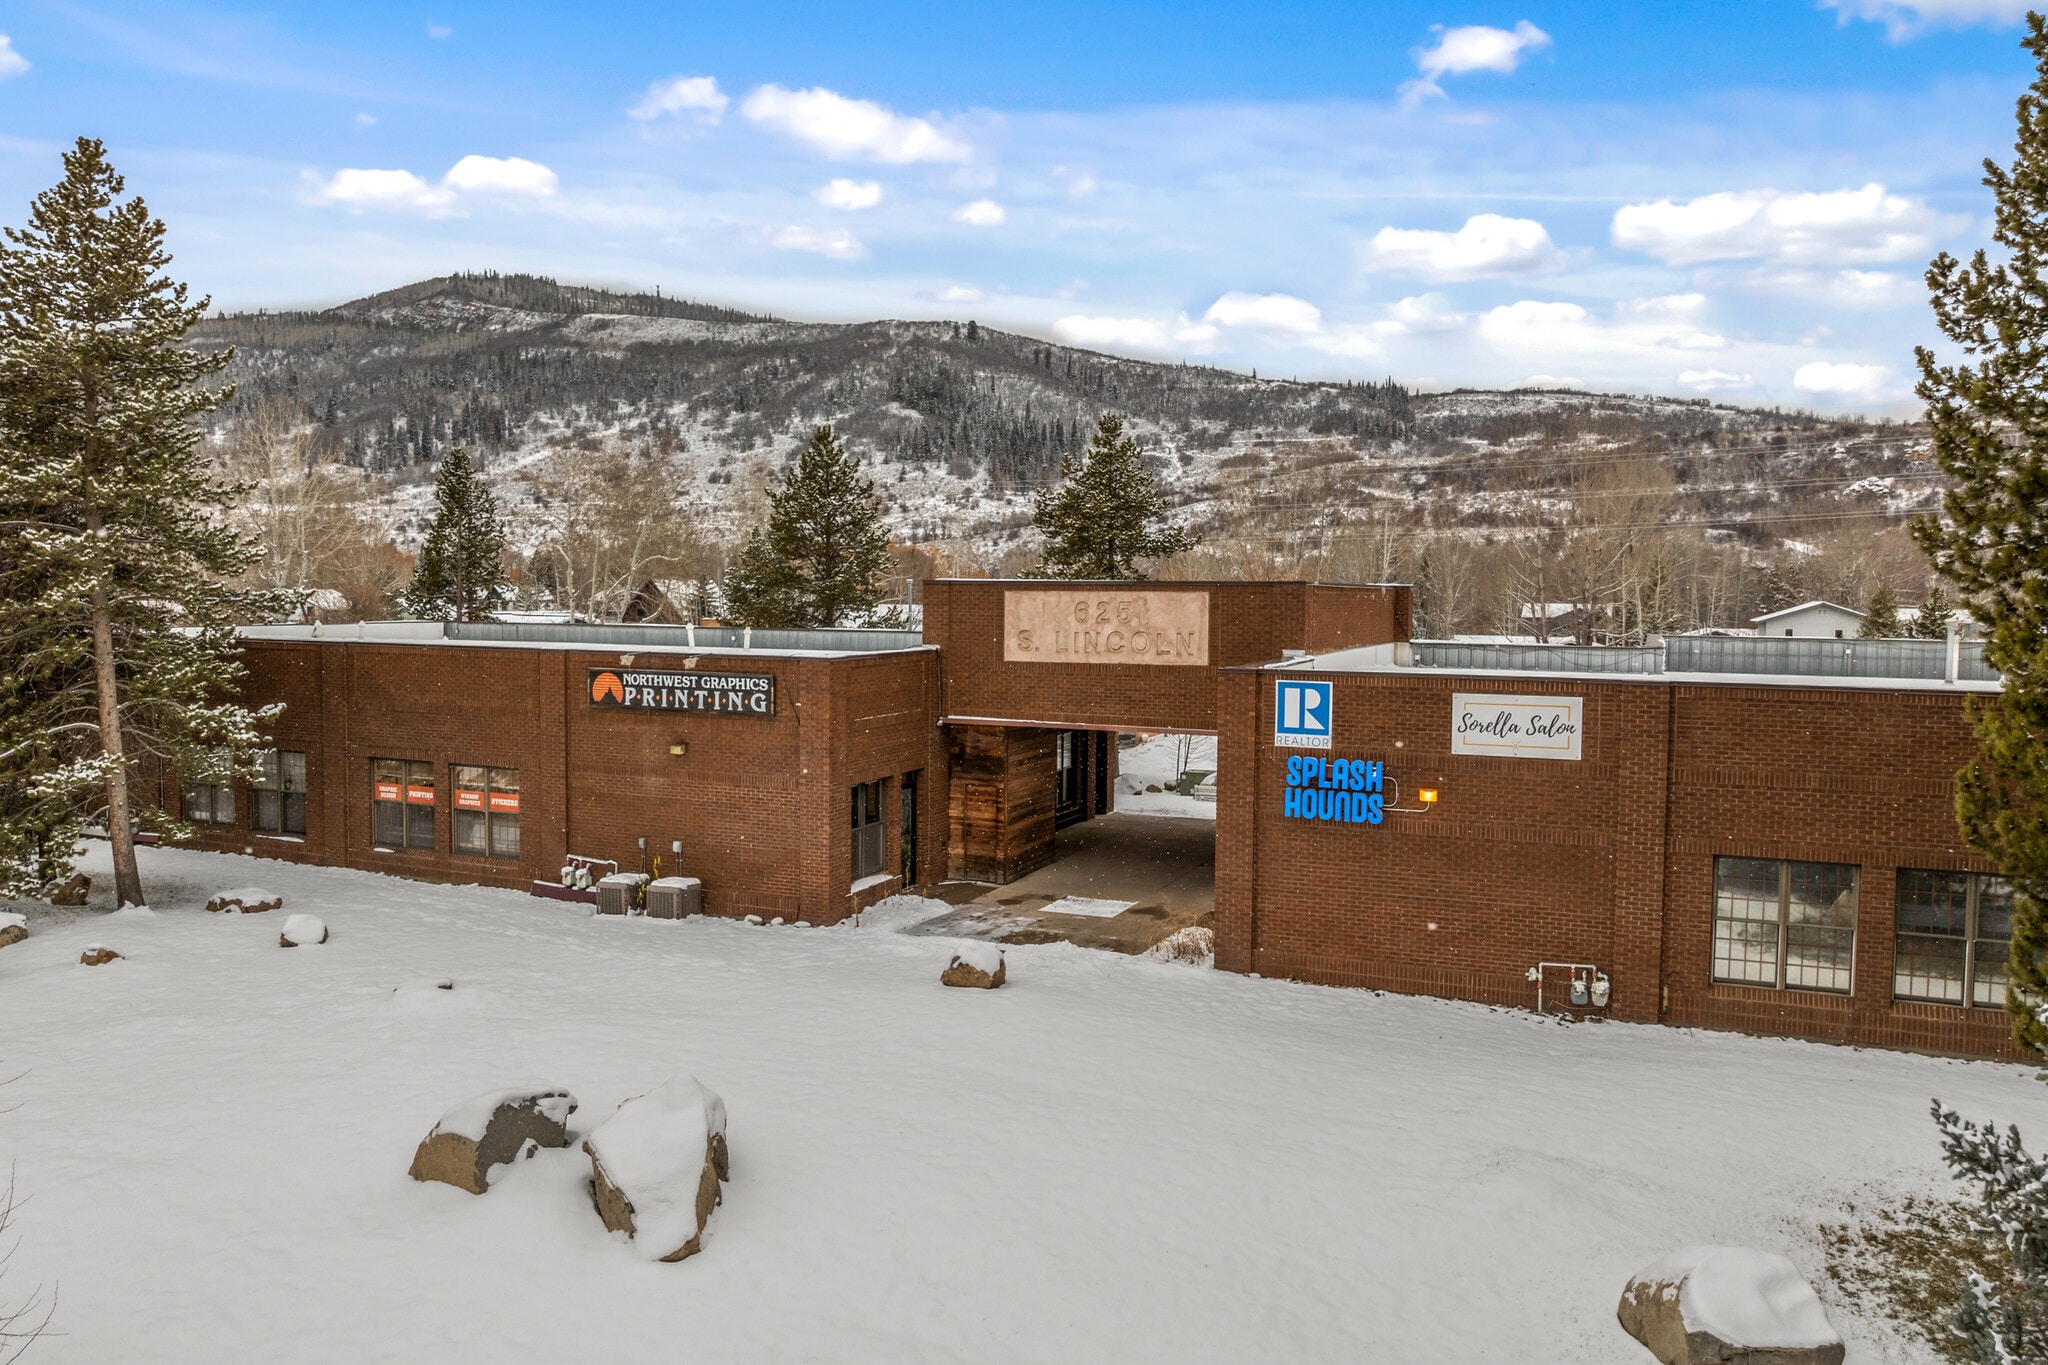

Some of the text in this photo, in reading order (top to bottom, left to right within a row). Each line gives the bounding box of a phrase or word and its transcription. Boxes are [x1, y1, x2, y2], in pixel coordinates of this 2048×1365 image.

[1074, 600, 1132, 624] 625
[1017, 629, 1195, 656] S. LINCOLN
[623, 673, 769, 691] NORTHWEST GRAPHICS
[1457, 710, 1577, 738] Sorella Salon
[1286, 755, 1384, 792] SPLASH
[409, 791, 434, 799] PRINTING
[491, 798, 519, 807] STICKERS
[1284, 787, 1384, 825] HOUNDS
